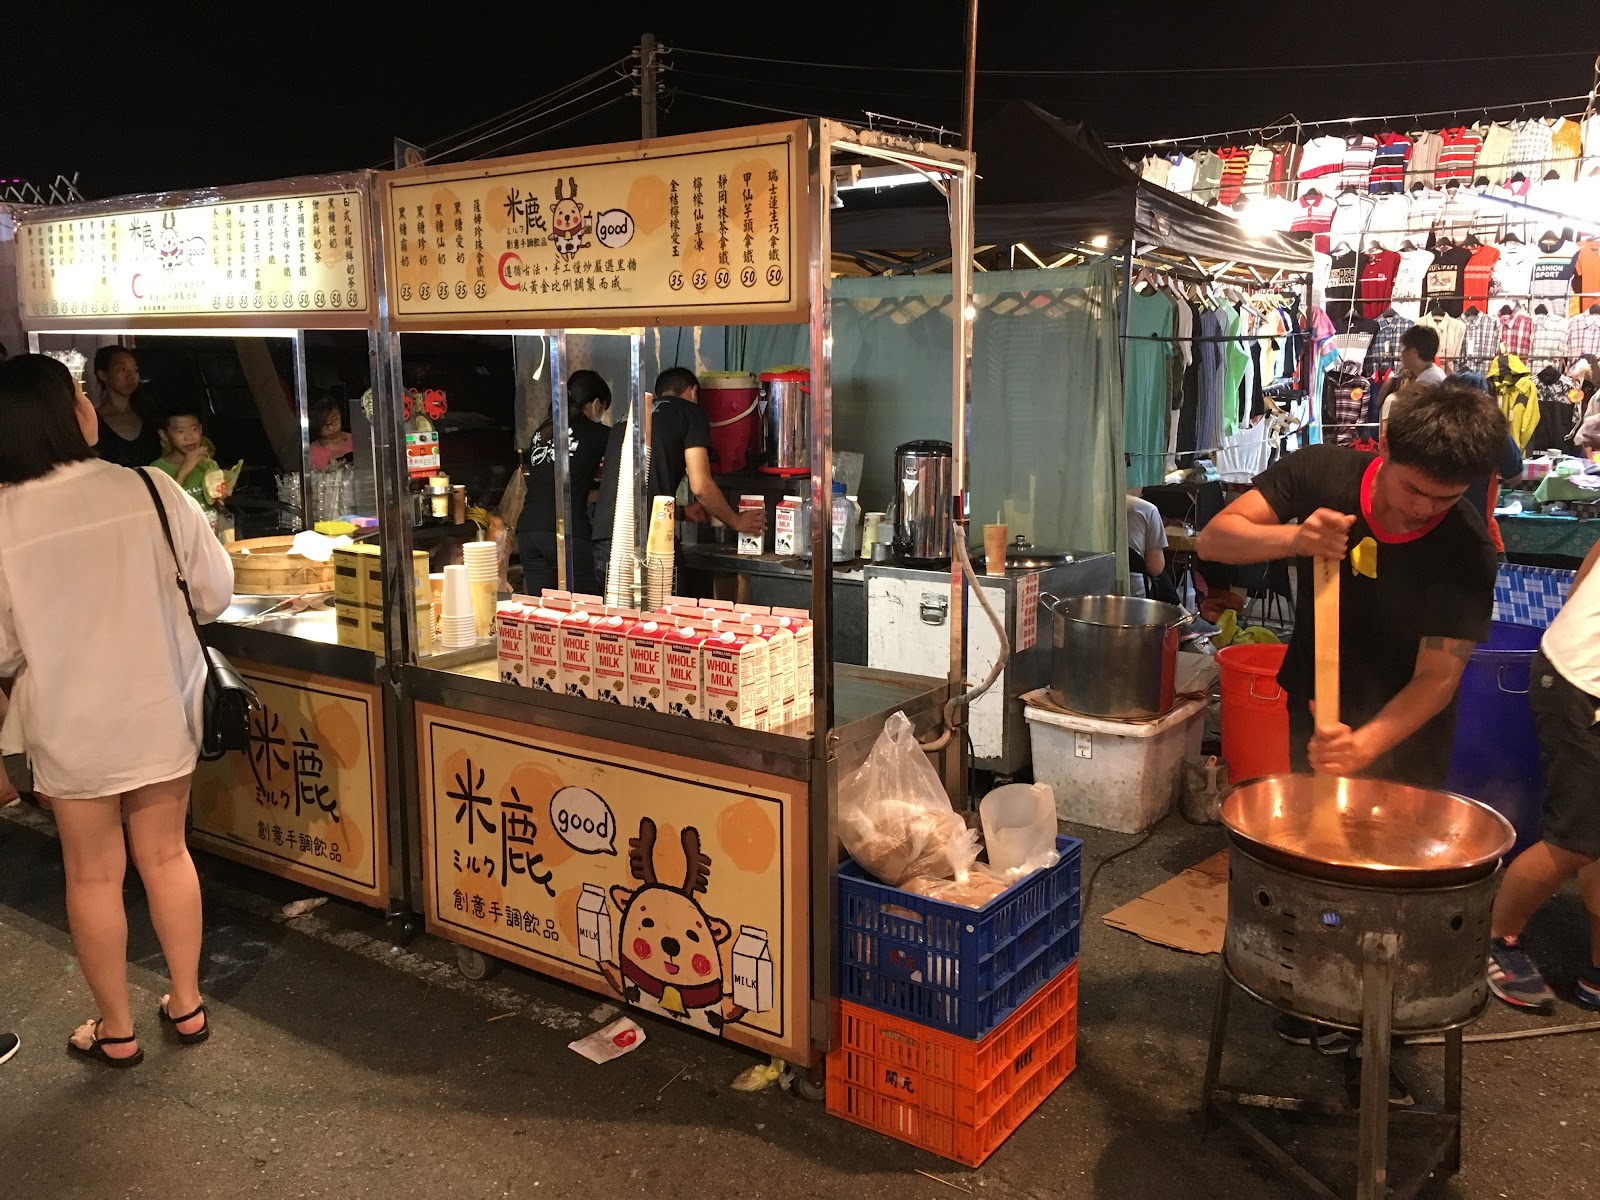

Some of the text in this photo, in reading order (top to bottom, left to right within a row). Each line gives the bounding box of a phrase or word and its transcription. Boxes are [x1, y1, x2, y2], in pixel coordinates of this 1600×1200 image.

[503, 187, 547, 235] 米鹿
[669, 179, 681, 257] 金桔檸檬愛玉
[717, 174, 729, 266] 靜岡抹茶拿鐵
[742, 172, 754, 264] 甲仙芋頭拿鐵
[768, 168, 780, 262] 瑞士蓮生巧拿鐵
[328, 198, 337, 249] 黑糖純奶
[434, 203, 447, 265] 黑糖仙奶
[453, 201, 465, 264] 黑糖愛奶
[600, 217, 628, 240] good
[344, 198, 355, 289] 日式札幌鮮奶茶
[416, 204, 428, 266] 黑糖珍奶
[506, 237, 548, 250] 創意手調飲品
[519, 275, 622, 294] 以黃金比例調製而成
[499, 627, 523, 641] WHOLE
[530, 632, 556, 645] WHOLE
[563, 637, 590, 651] WHOLE
[502, 639, 519, 652] MILK
[533, 645, 552, 657] MILK
[595, 642, 624, 656] WHOLE
[630, 648, 660, 662] WHOLE
[566, 650, 586, 663] MILK
[599, 656, 620, 668] MILK
[666, 653, 696, 668] WHOLE
[706, 659, 738, 674] WHOLE
[634, 662, 656, 675] MILK
[670, 667, 692, 681] MILK
[710, 673, 733, 687] MILK
[250, 704, 339, 823] 米鹿
[446, 758, 556, 898] 米鹿
[557, 808, 609, 840] good
[257, 820, 342, 863] 創意手調飲品
[453, 849, 495, 878] ミルク
[452, 888, 560, 943] 創意手調飲品
[579, 927, 599, 941] MILK
[733, 974, 757, 989] MILK
[884, 1068, 915, 1094] 開元
